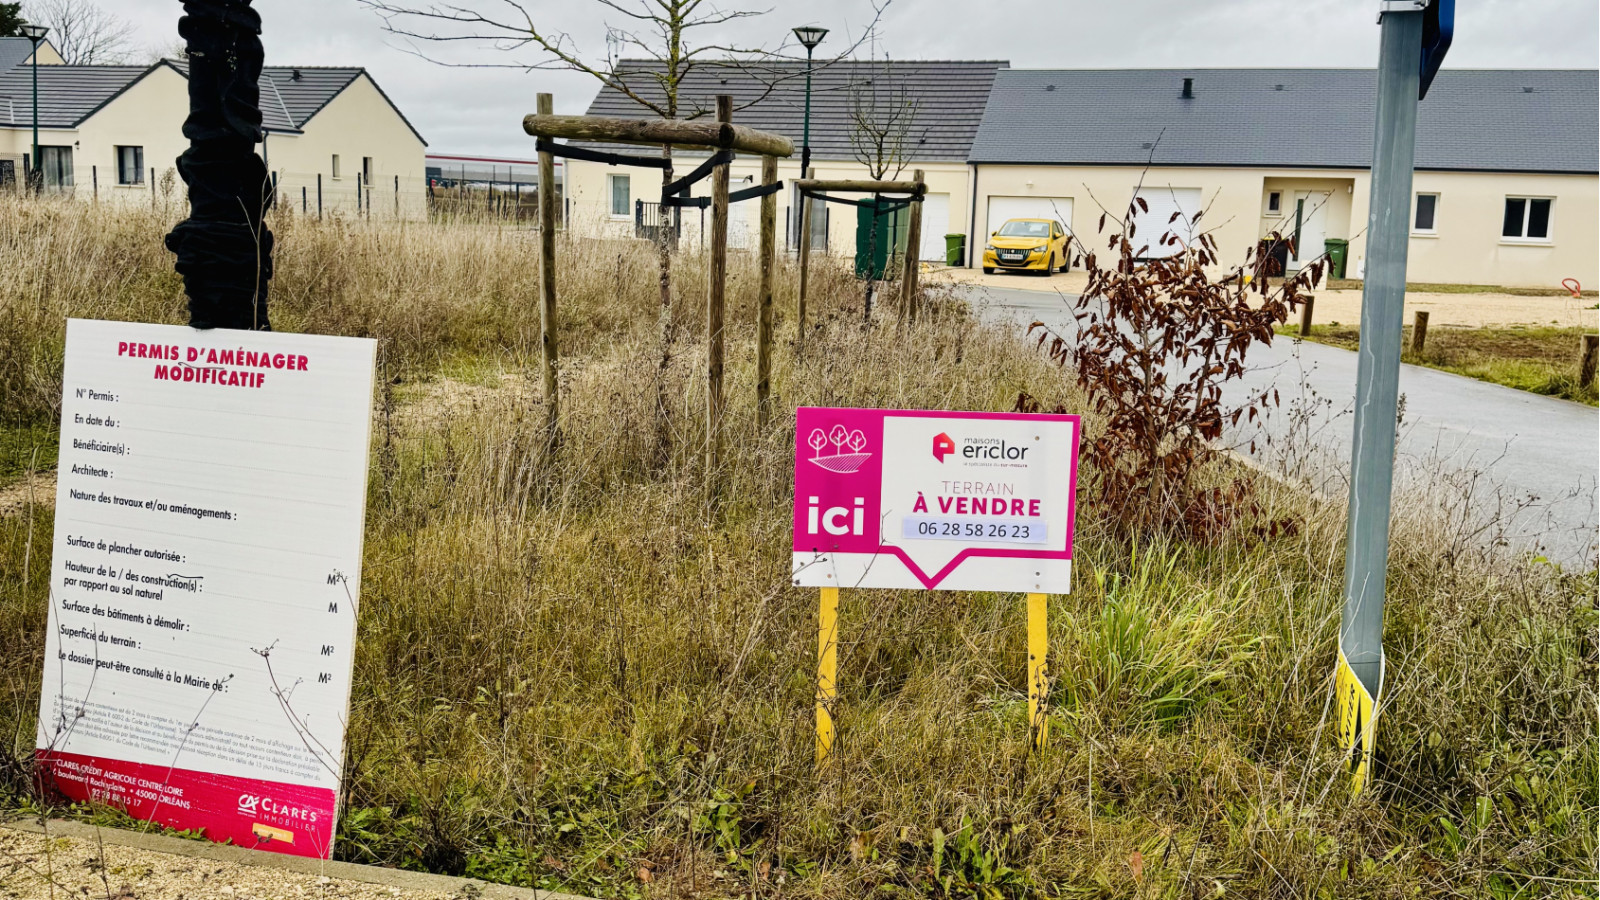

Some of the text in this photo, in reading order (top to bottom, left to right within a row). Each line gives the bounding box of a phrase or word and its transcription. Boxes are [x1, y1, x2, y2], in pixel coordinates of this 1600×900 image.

[118, 342, 308, 370] PERMIS D'AMÉNAGER
[154, 364, 264, 388] MODIFICATIF
[76, 388, 86, 398] N°
[88, 389, 113, 401] Permis
[74, 413, 83, 423] En
[85, 413, 102, 425] date
[104, 415, 114, 427] du
[73, 438, 124, 455] Bénéficiaire(s)
[963, 440, 1028, 460] ericlor
[71, 463, 108, 477] Architecte
[942, 480, 1013, 495] TERRAIN
[69, 488, 96, 501] Nature
[97, 491, 111, 503] des
[113, 495, 142, 508] travaux
[145, 499, 167, 511] et/ou
[169, 503, 231, 519] aménagements
[912, 491, 1040, 516] À VENDRE
[807, 495, 864, 535] ici
[918, 521, 1029, 538] 06 28 58 26 23
[66, 534, 94, 548] Surface
[96, 539, 106, 550] de
[108, 541, 142, 555] plancher
[143, 549, 180, 562] autorisée
[65, 560, 95, 574] Hauteur
[96, 564, 106, 576] de
[108, 566, 116, 577] la
[125, 569, 138, 581] des
[140, 574, 197, 592] construction(s)
[63, 577, 162, 600] par rapport au sol naturel
[62, 599, 89, 613] Surface
[91, 604, 104, 616] des
[107, 606, 144, 623] bâtiments
[146, 614, 151, 624] à
[153, 614, 184, 630] démolir
[328, 602, 337, 613] M
[60, 624, 96, 640] Superficie
[98, 630, 108, 642] du
[110, 635, 135, 648] terrain
[320, 644, 333, 656] M²
[67, 650, 94, 665] dossier
[96, 657, 130, 673] peut-être
[132, 667, 163, 679] consulté
[165, 671, 171, 681] à
[173, 671, 181, 683] la
[183, 674, 209, 688] Mairie
[318, 672, 331, 683] M²
[57, 759, 79, 770] CLARES
[104, 770, 136, 785] AGRICOLE
[137, 778, 163, 792] CENTRE
[164, 784, 183, 796] LOIRE
[123, 796, 130, 804] 15
[133, 798, 141, 806] 17
[137, 789, 157, 800] 45000
[159, 793, 190, 809] ORLÉANS
[262, 798, 316, 822] CLARES
[260, 814, 315, 832] IMMOBILIER
